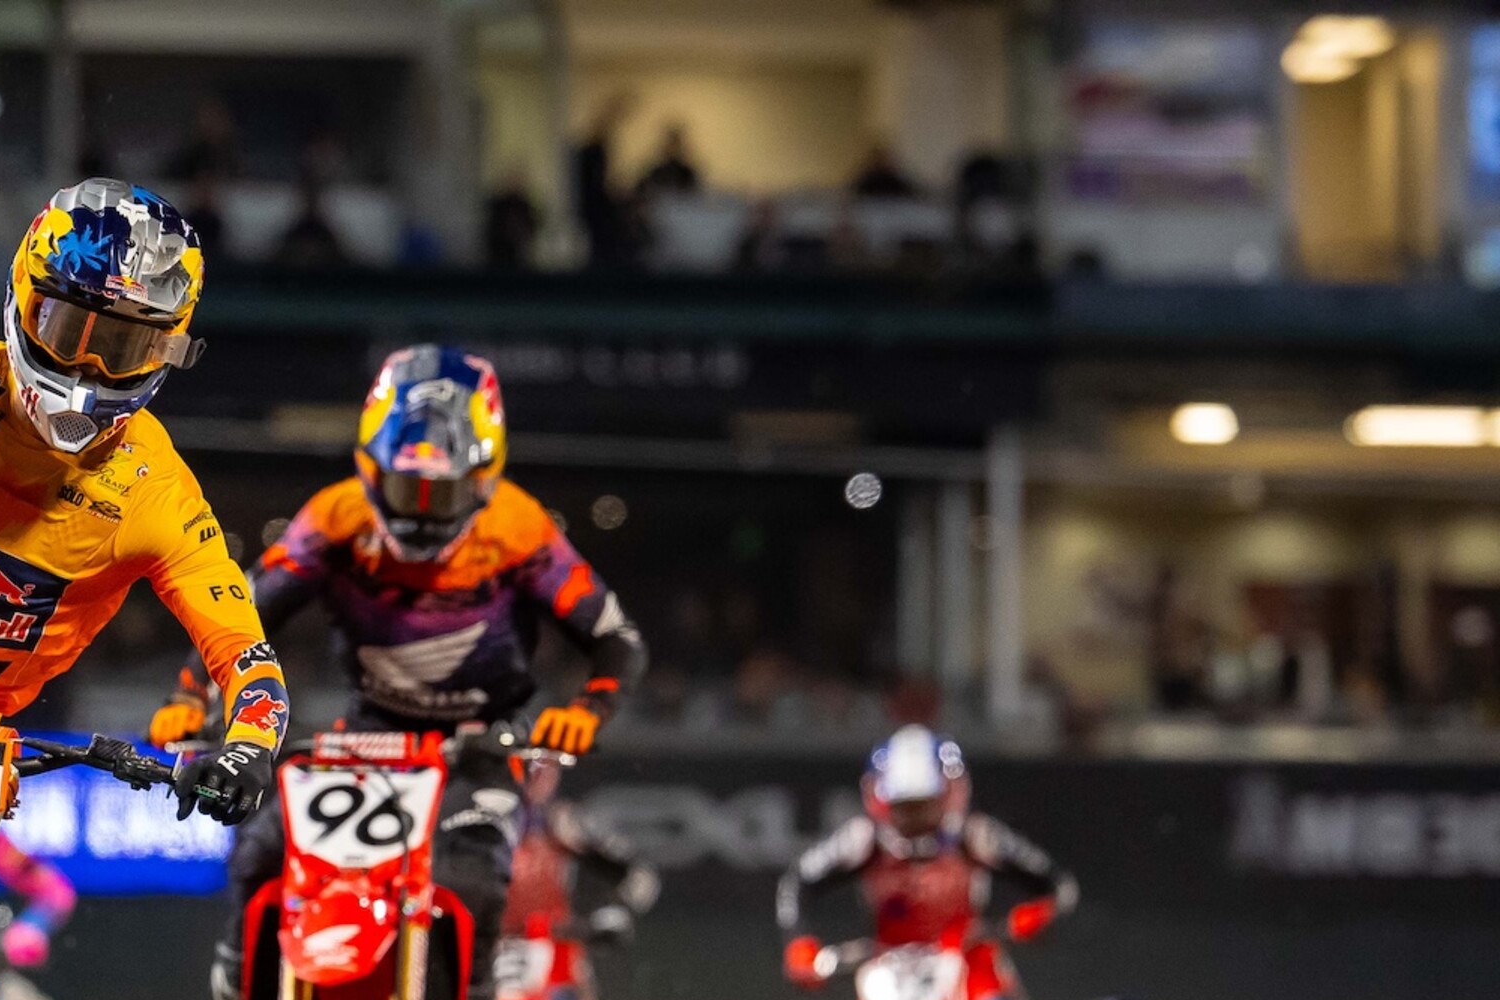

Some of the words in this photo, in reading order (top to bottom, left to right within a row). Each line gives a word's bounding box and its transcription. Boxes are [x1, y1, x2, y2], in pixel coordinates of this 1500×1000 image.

[209, 584, 253, 604] FO
[218, 743, 259, 777] FOX
[308, 785, 414, 846] 96
